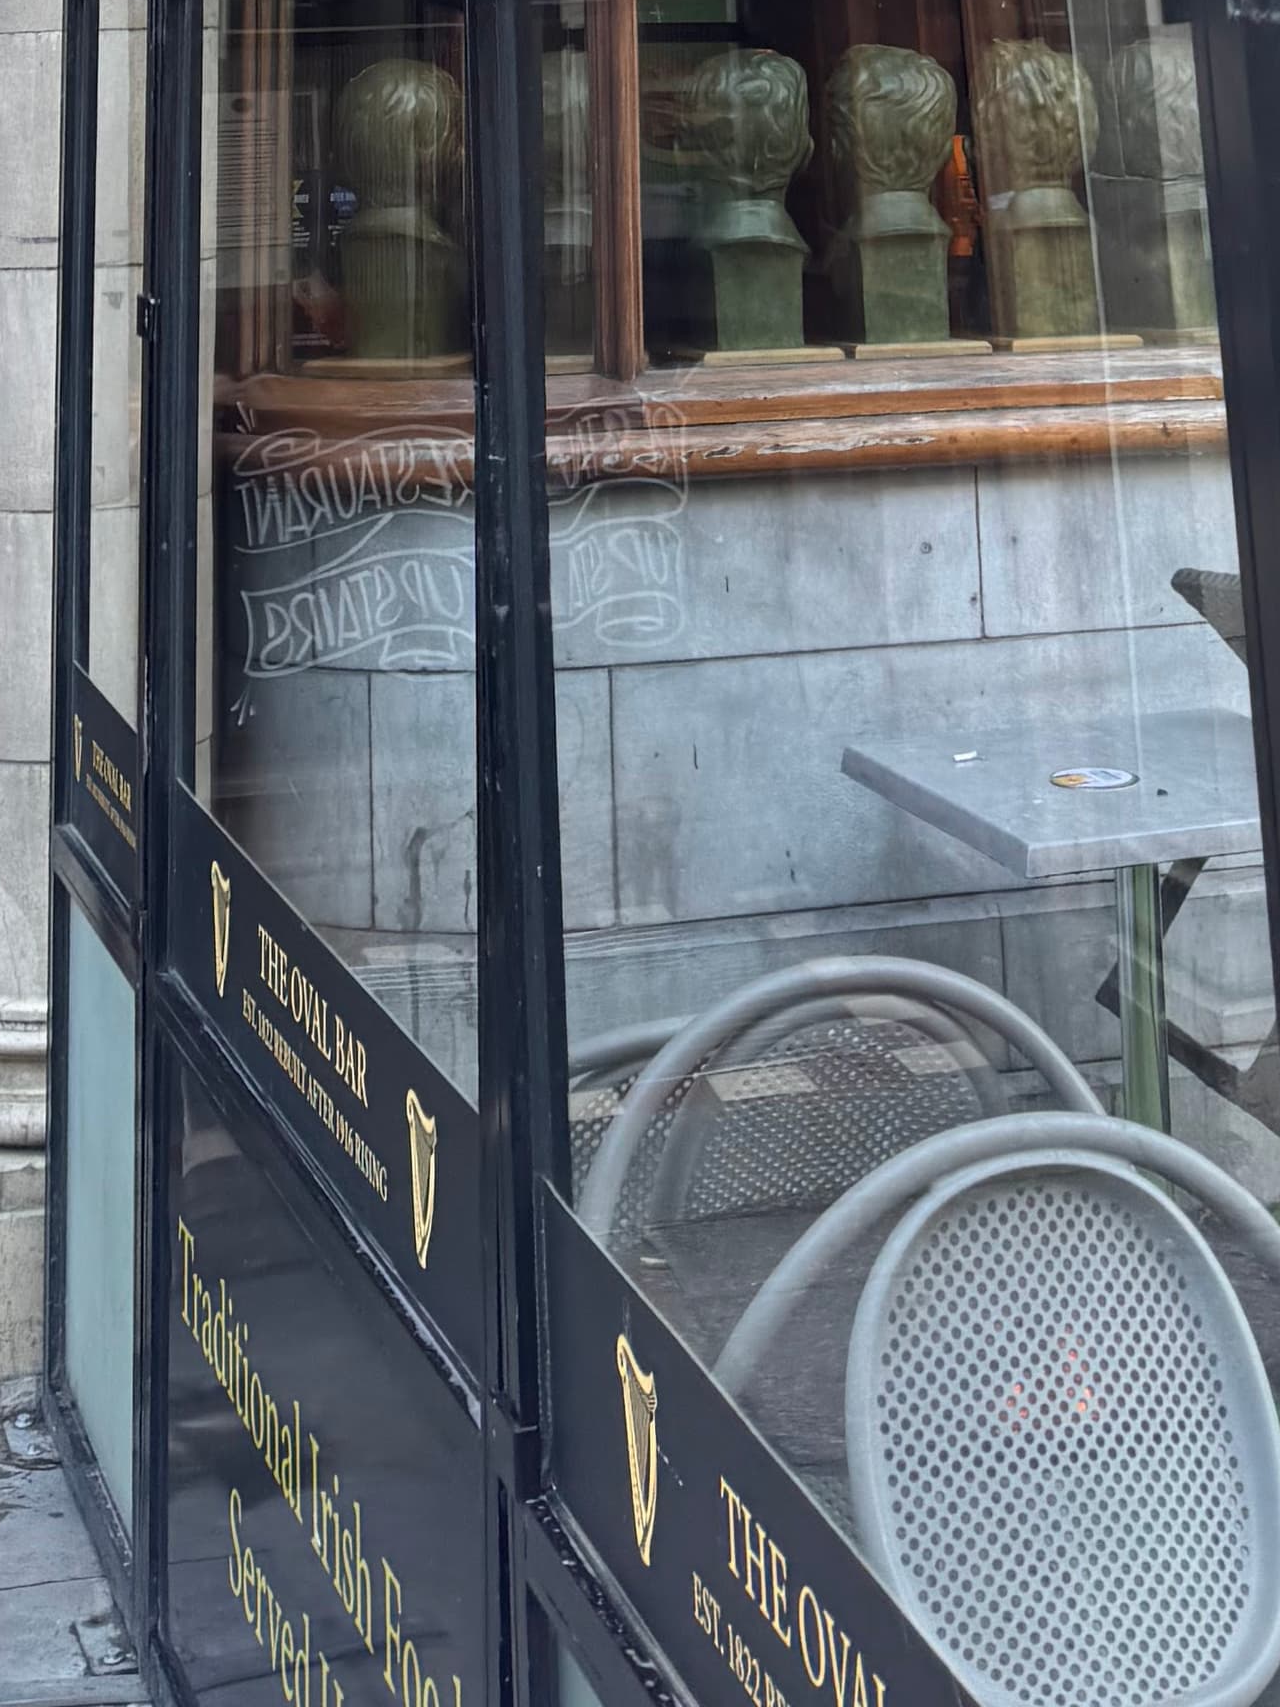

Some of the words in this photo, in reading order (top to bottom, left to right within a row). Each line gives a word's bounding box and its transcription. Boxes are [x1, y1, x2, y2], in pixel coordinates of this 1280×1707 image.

[258, 923, 289, 1008] THE
[291, 965, 332, 1062] OVAL
[335, 1013, 369, 1109] BAR
[273, 1027, 307, 1095] REBUILT
[306, 1073, 335, 1134] AFTER
[336, 1109, 354, 1158] 1916
[354, 1132, 388, 1203] RISING
[177, 1214, 304, 1526] Traditional
[308, 1432, 375, 1655] Irish
[381, 1556, 462, 1707] Fo
[228, 1487, 310, 1707] Served
[693, 1571, 725, 1655] EST.
[726, 1623, 762, 1707] 1822
[720, 1475, 792, 1648] THE
